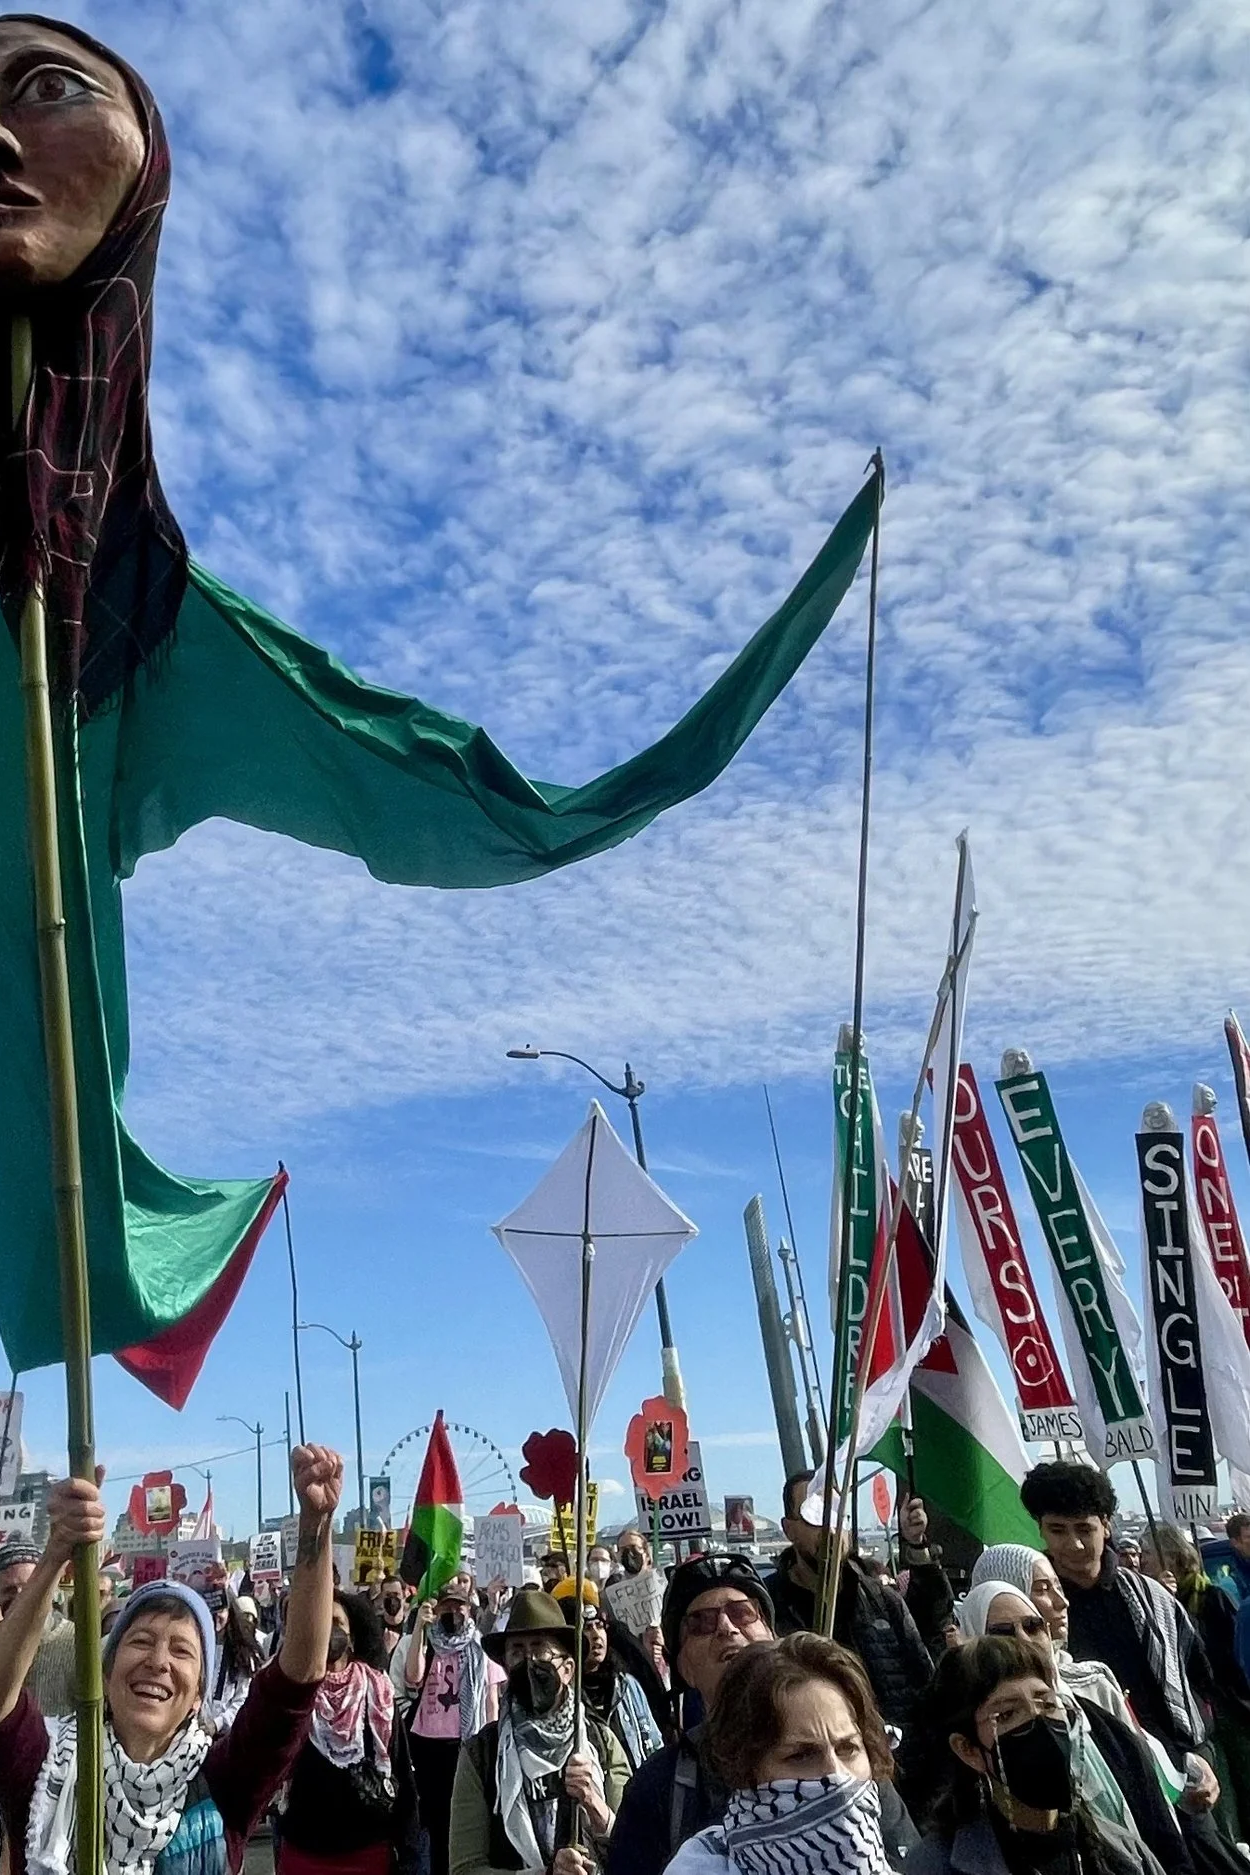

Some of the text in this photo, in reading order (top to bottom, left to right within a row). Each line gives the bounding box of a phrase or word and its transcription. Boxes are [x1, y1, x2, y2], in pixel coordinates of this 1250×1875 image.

[839, 1089, 870, 1424] CHILDRE
[953, 1077, 1036, 1326] OURS
[1000, 1079, 1125, 1418] EVERY
[1196, 1122, 1240, 1262] ONE
[1143, 1142, 1205, 1478] SINGLE
[1026, 1411, 1083, 1439] JAMES
[1104, 1425, 1154, 1458] BALD
[1173, 1493, 1211, 1520] WIN
